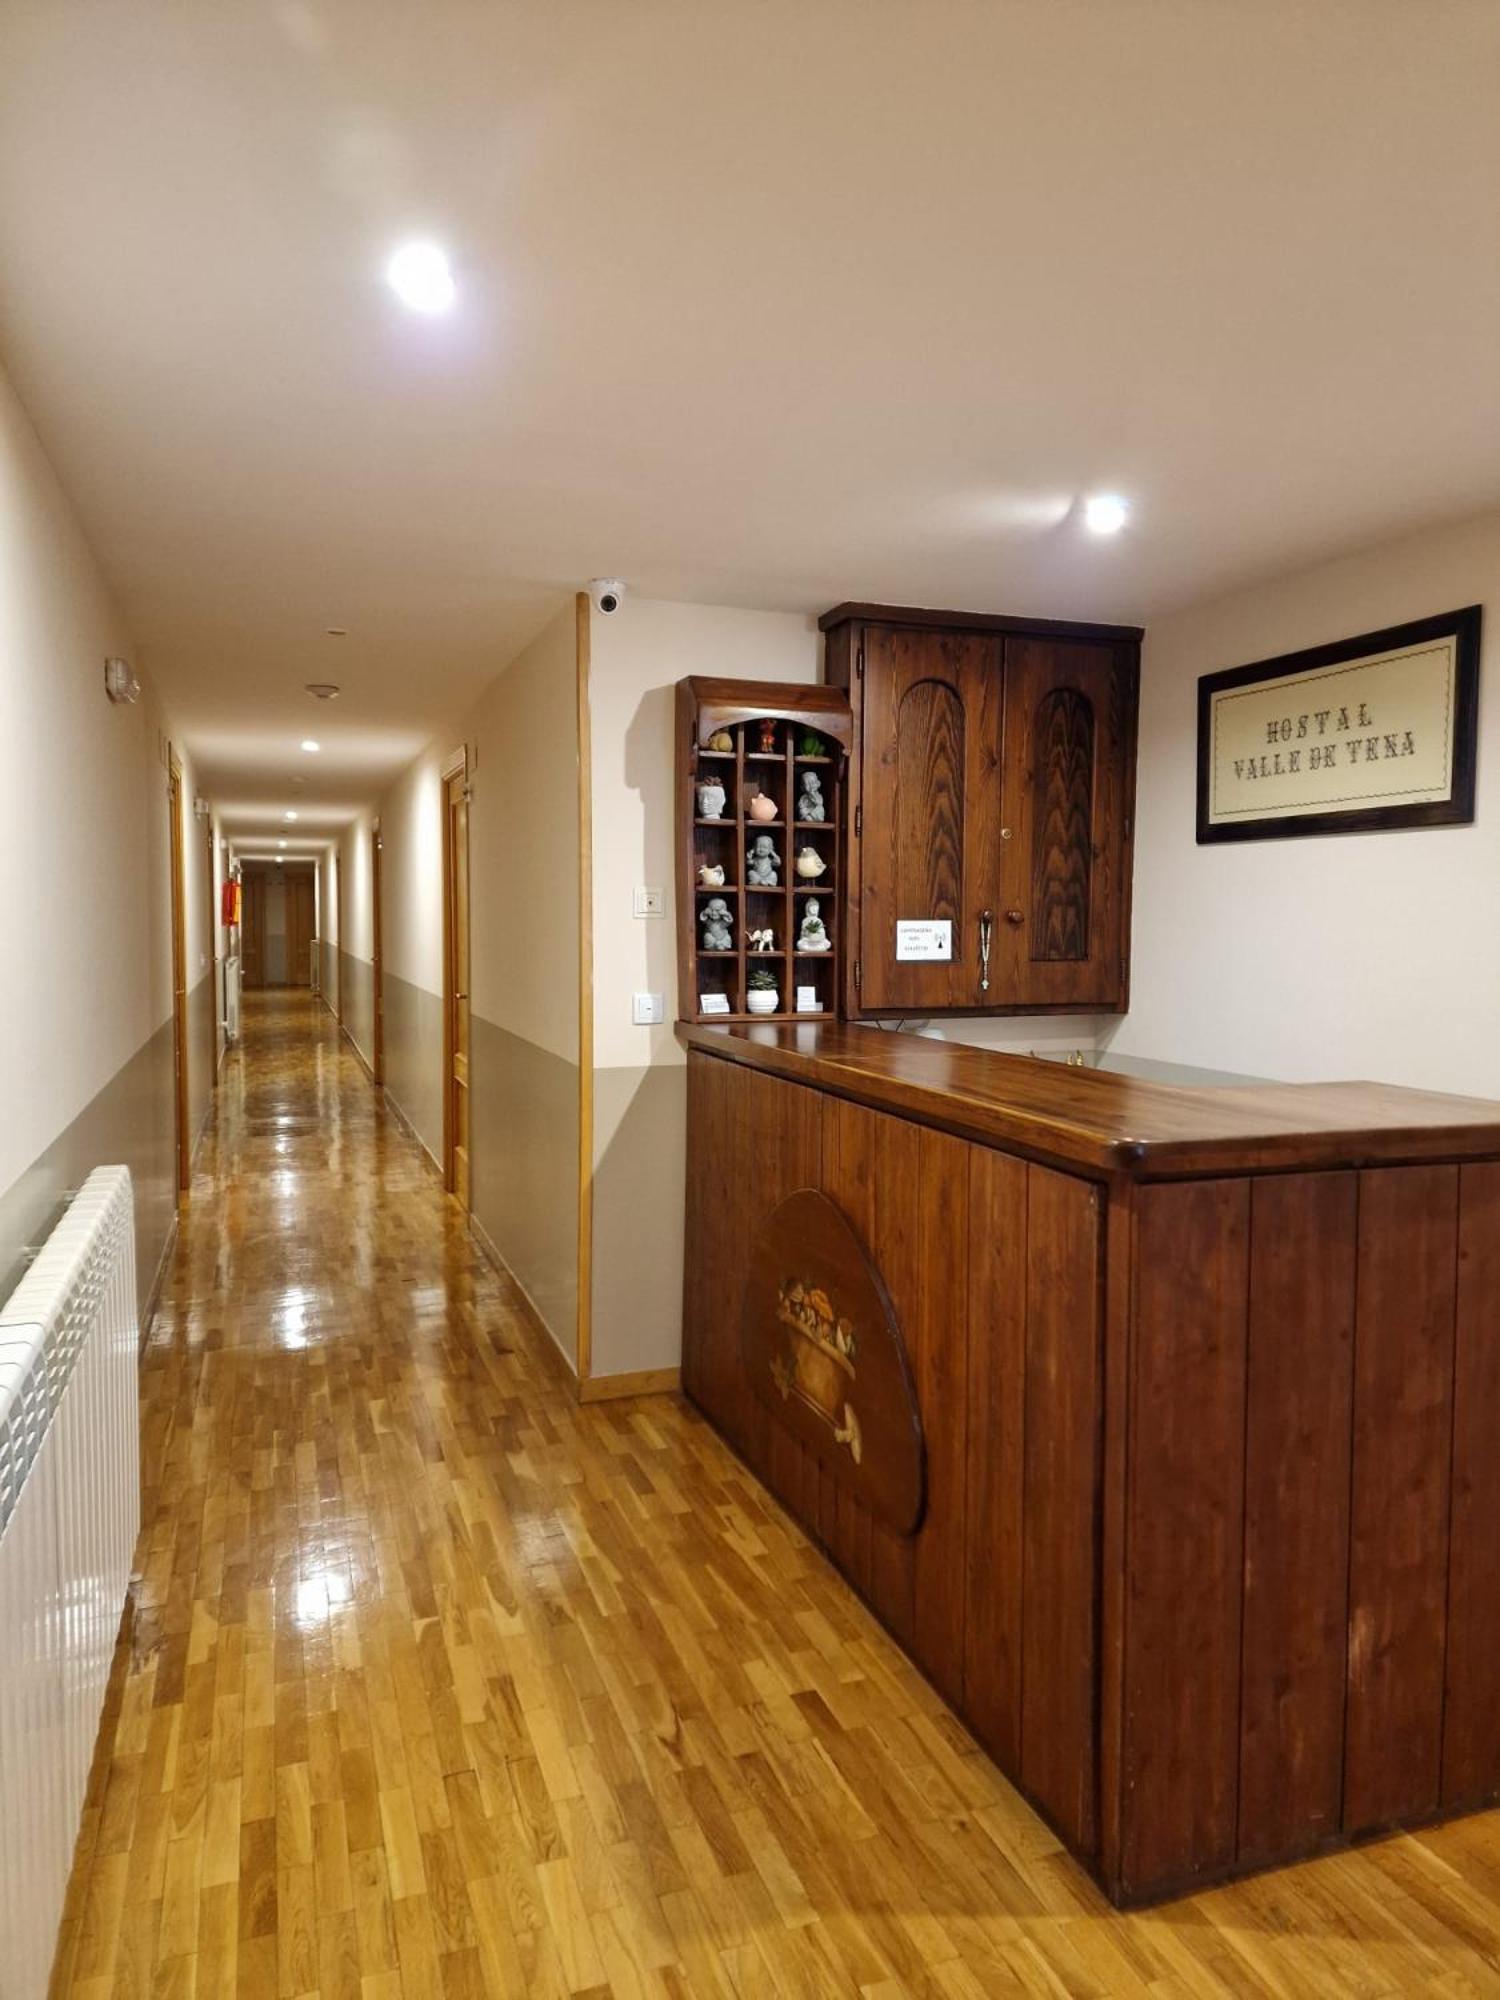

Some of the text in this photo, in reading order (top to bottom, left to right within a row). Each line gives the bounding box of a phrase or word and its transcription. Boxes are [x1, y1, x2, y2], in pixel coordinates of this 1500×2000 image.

[1266, 703, 1372, 744] HOSTAL
[1234, 731, 1415, 780] VALLE DE TENA
